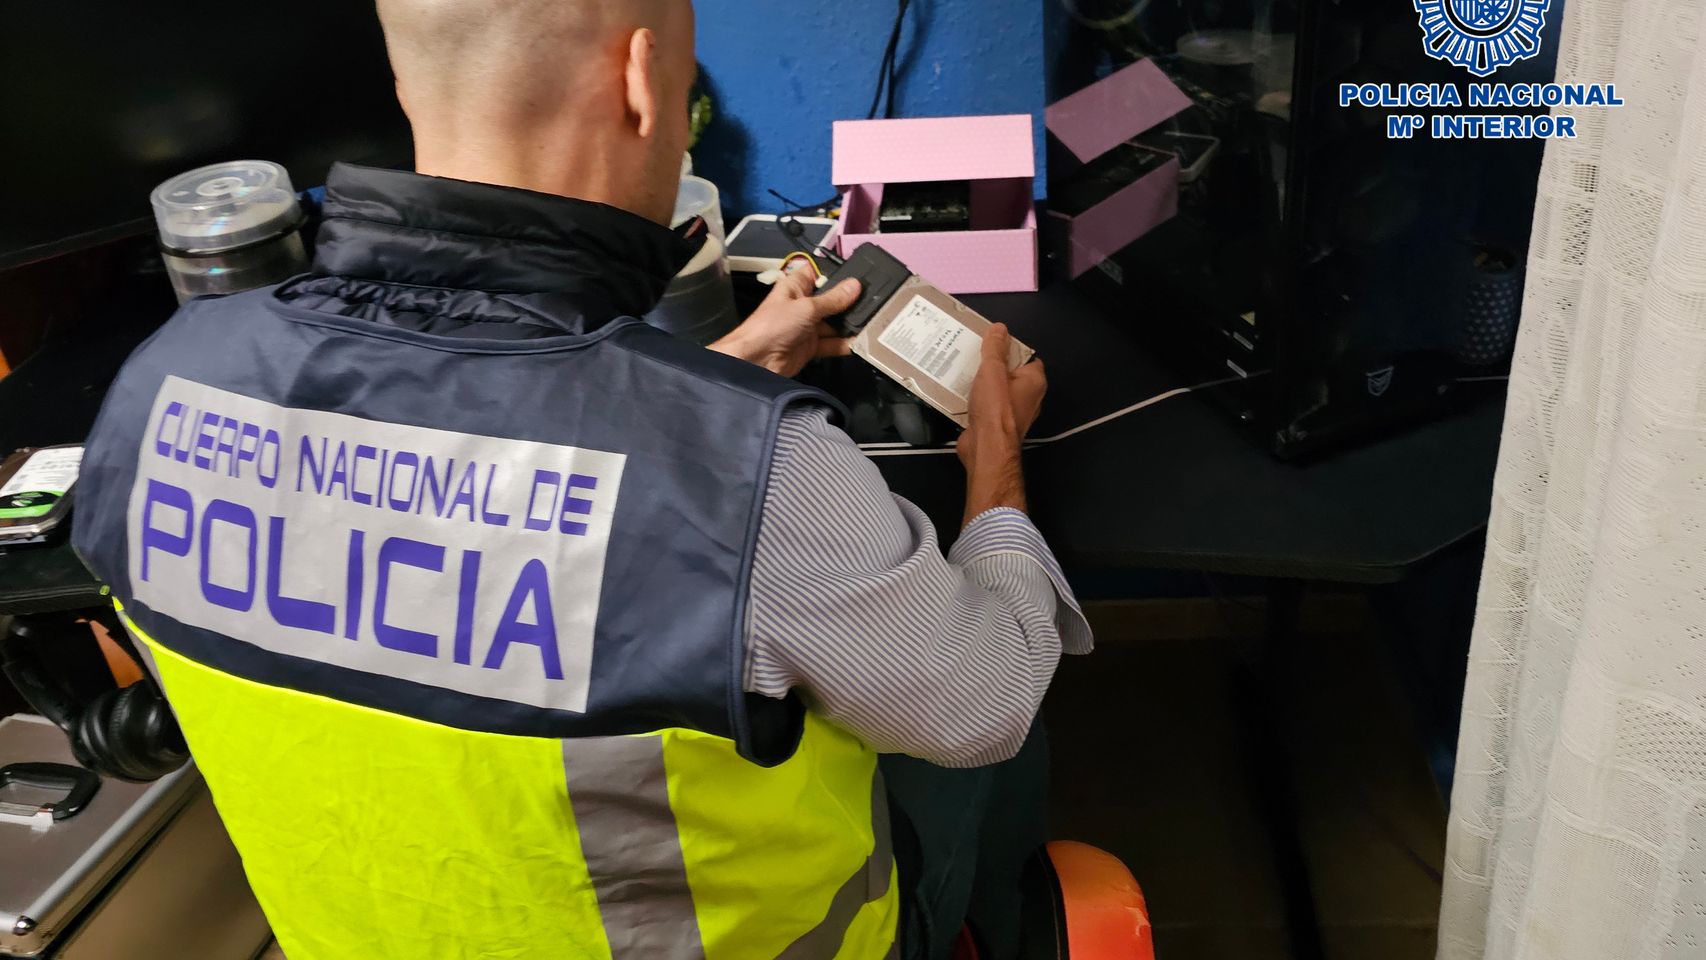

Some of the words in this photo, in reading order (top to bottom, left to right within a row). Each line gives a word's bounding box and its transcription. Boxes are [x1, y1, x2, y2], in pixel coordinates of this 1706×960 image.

[156, 402, 280, 488] CUERPO
[297, 435, 510, 526] NACIONAL
[525, 470, 598, 535] DE
[141, 478, 563, 680] POLICIA
